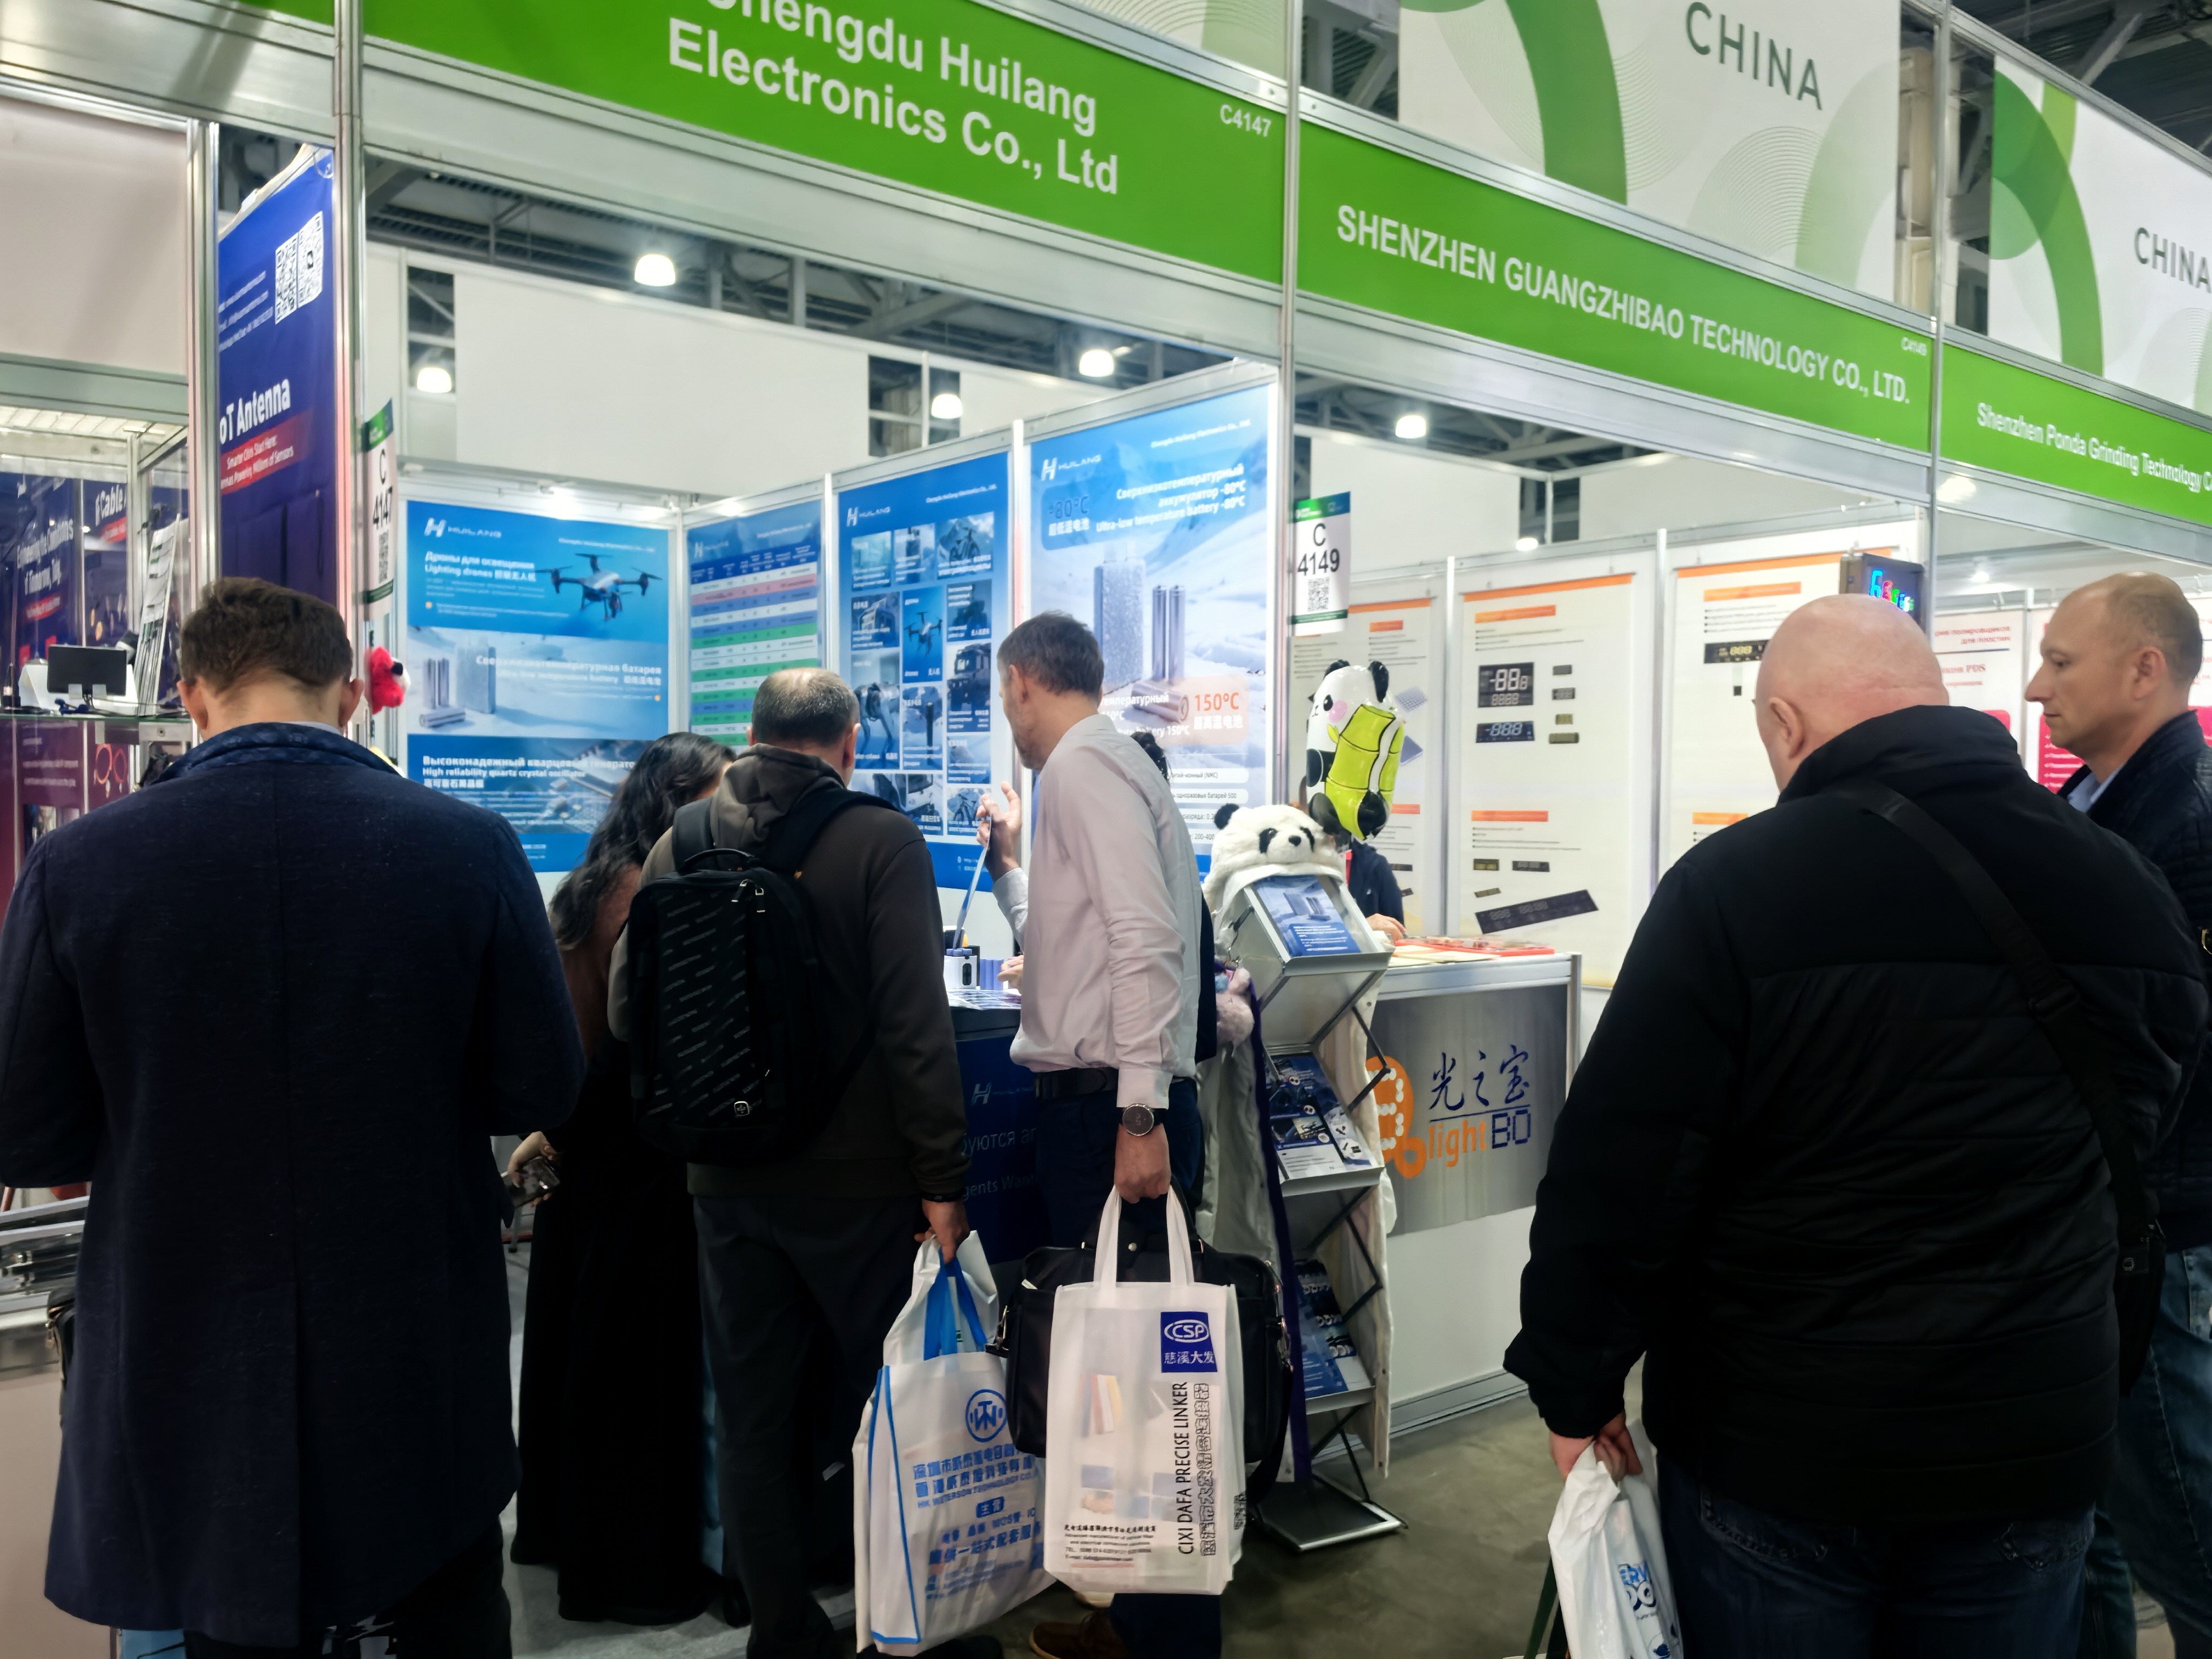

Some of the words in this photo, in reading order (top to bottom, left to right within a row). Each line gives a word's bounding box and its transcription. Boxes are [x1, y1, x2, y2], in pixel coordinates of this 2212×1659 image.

[706, 0, 923, 72] engdu
[940, 36, 1096, 137] Huilang
[1685, 2, 1823, 110] CHINA
[669, 18, 946, 144] Electronics
[962, 112, 1042, 180] Co.,
[1057, 139, 1118, 194] Ltd
[1219, 105, 1271, 138] C4147
[2134, 227, 2212, 294] CHINA
[1337, 205, 1496, 284] SHENZHEN
[1505, 257, 1684, 339] GUANGZHIBAO
[1691, 315, 1828, 378] TECHNOLOGY
[1833, 359, 1869, 399] CO.,
[1873, 372, 1910, 403] LTD.
[237, 379, 291, 437] Antenna
[379, 448, 386, 484] C
[1977, 402, 2044, 444] Shenzhen
[2088, 437, 2140, 476] Grinding
[2141, 452, 2202, 493] Technology
[373, 486, 393, 530] 4147
[1186, 502, 1219, 517] battery
[1313, 522, 1326, 547] C
[1298, 548, 1340, 576] 4149
[1429, 1044, 1530, 1111] 光之宝
[1172, 1323, 1207, 1339] CSP
[1163, 1350, 1215, 1365] 慈溪大发
[1172, 1382, 1189, 1429] LINKER
[1174, 1433, 1191, 1483] PRECISE
[1176, 1488, 1193, 1523] DAFA
[1177, 1527, 1194, 1555] CIXI
